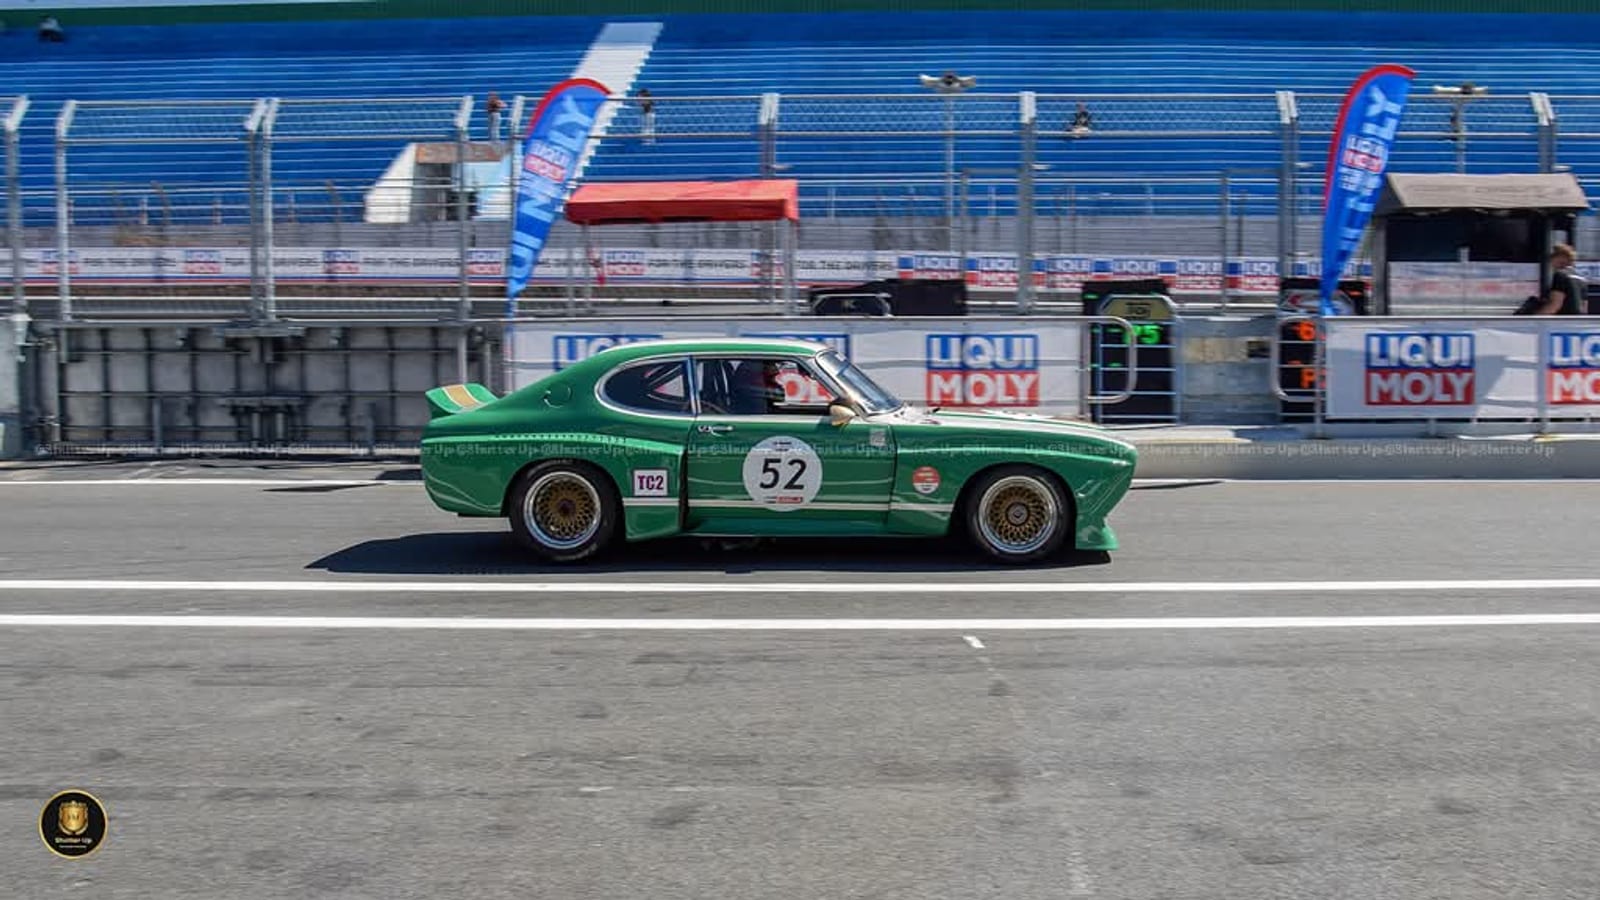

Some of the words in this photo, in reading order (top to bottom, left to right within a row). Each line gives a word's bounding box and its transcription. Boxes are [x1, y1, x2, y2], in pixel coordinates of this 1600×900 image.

[930, 337, 1031, 368] LIQUI
[1369, 336, 1472, 368] LIQUI
[930, 373, 1038, 404] MOLY
[1369, 373, 1473, 403] MOLY
[638, 475, 664, 490] TC2
[760, 458, 806, 489] 52
